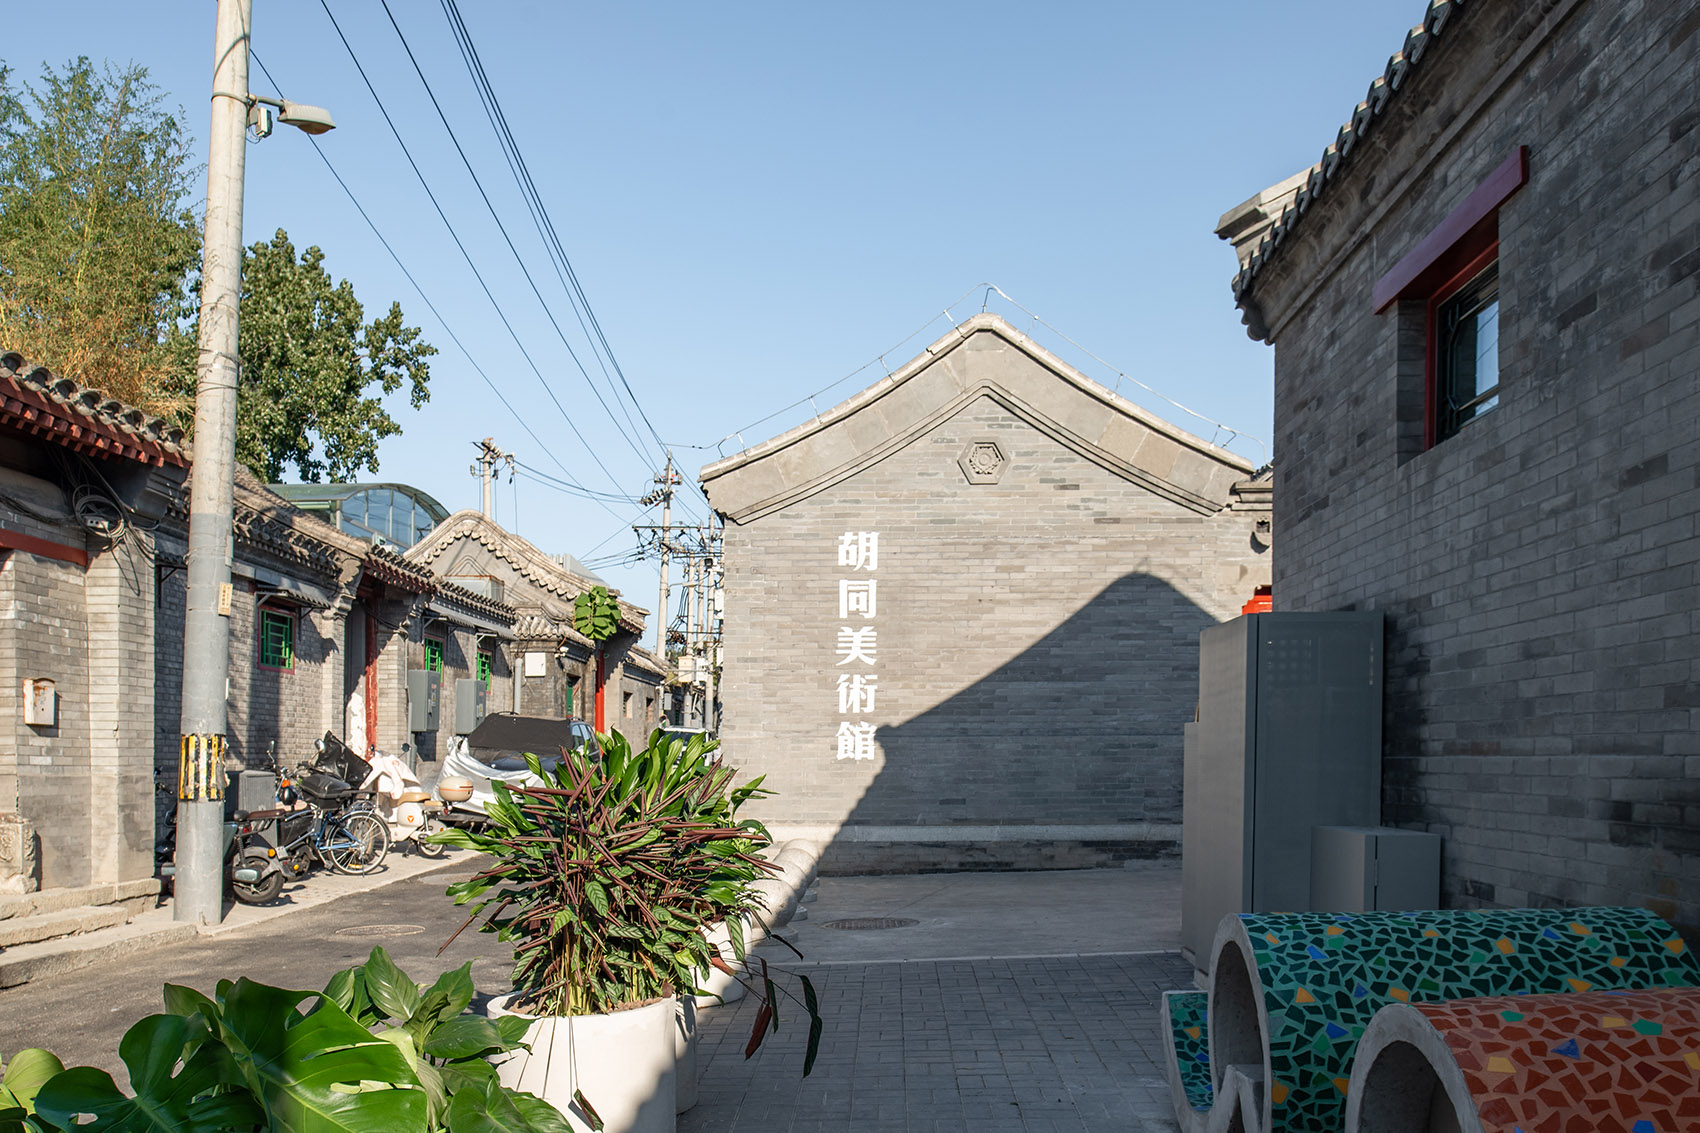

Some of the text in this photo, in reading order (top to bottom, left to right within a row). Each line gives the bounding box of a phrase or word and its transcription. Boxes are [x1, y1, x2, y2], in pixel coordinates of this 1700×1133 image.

[835, 531, 880, 761] 胡同美術館
